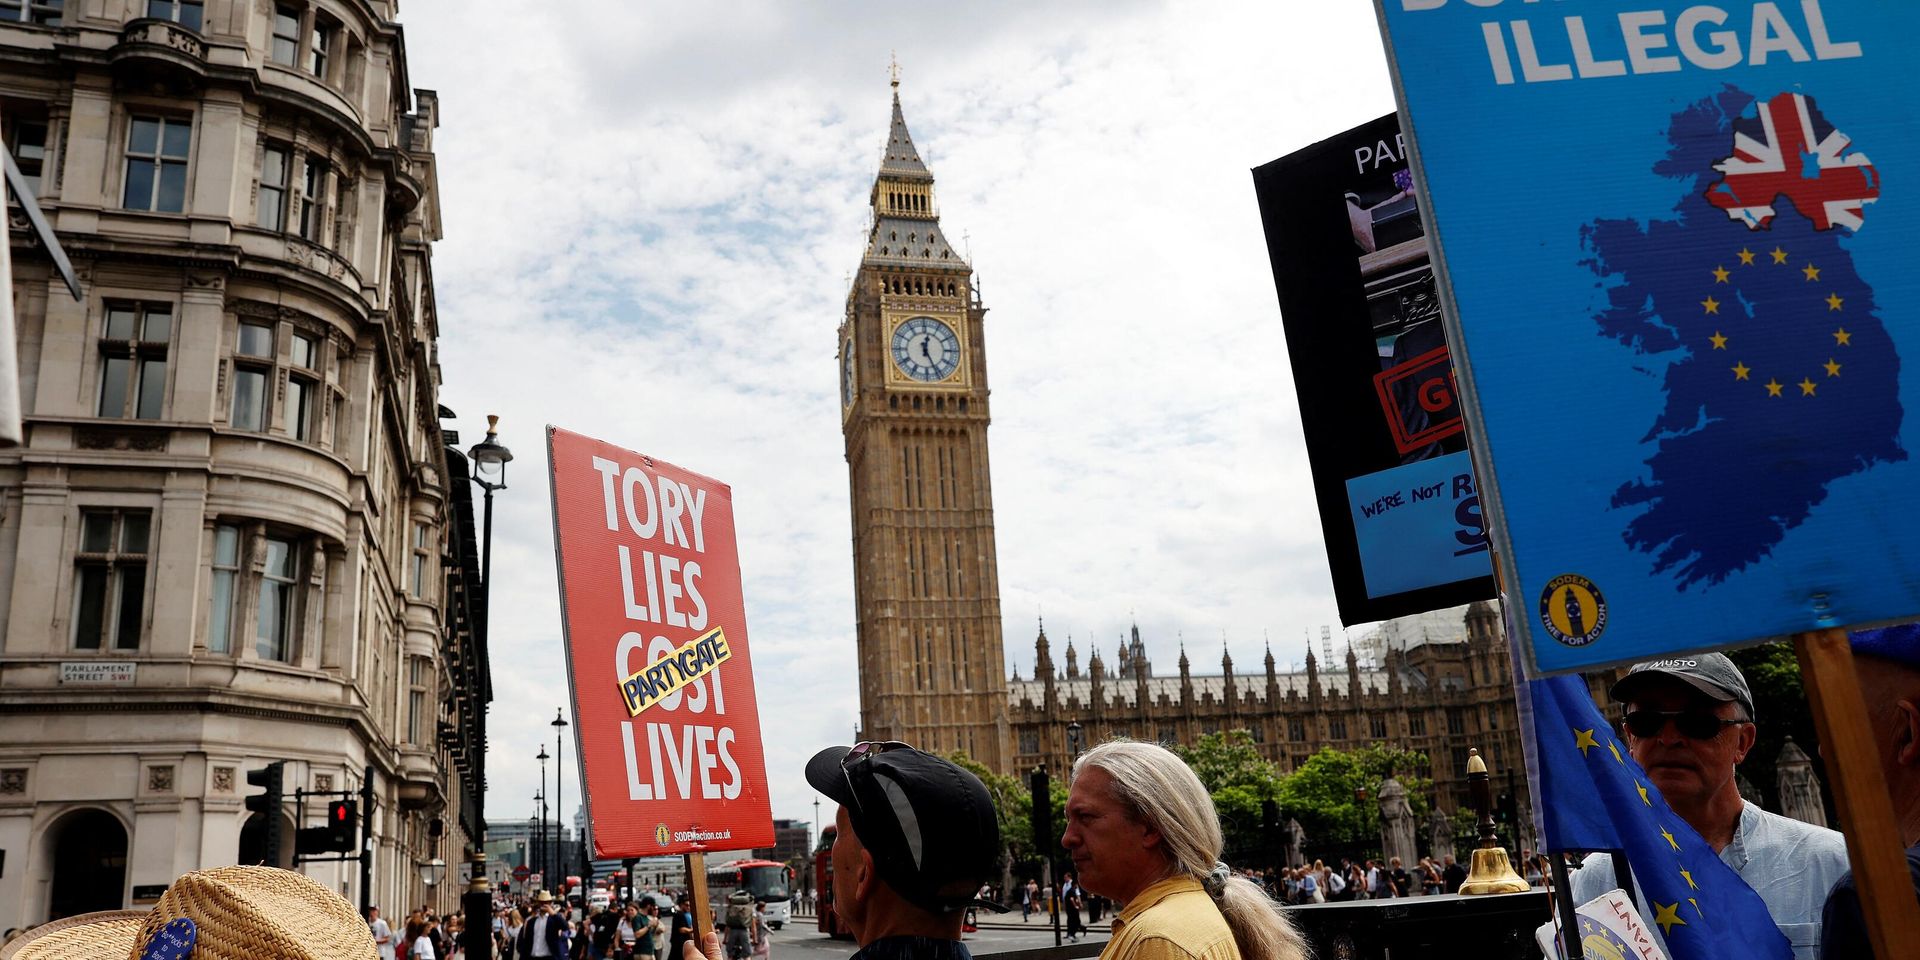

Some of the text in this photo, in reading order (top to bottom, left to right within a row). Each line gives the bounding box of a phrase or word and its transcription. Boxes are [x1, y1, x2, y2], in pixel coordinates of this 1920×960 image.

[1481, 0, 1862, 84] ILLEGAL
[592, 456, 706, 553] TORY
[1361, 473, 1477, 518] WE'RE NOT R
[618, 545, 708, 631] LIES
[1549, 576, 1590, 590] SODEM
[1543, 604, 1606, 645] TIME FOR ACTION
[624, 631, 728, 710] PARTYGATE
[1650, 659, 1698, 667] MUSTO
[621, 721, 742, 800] LIVES
[674, 829, 731, 842] SODEMaction.co.uk
[162, 944, 168, 952] to
[1609, 900, 1660, 960] TANT
